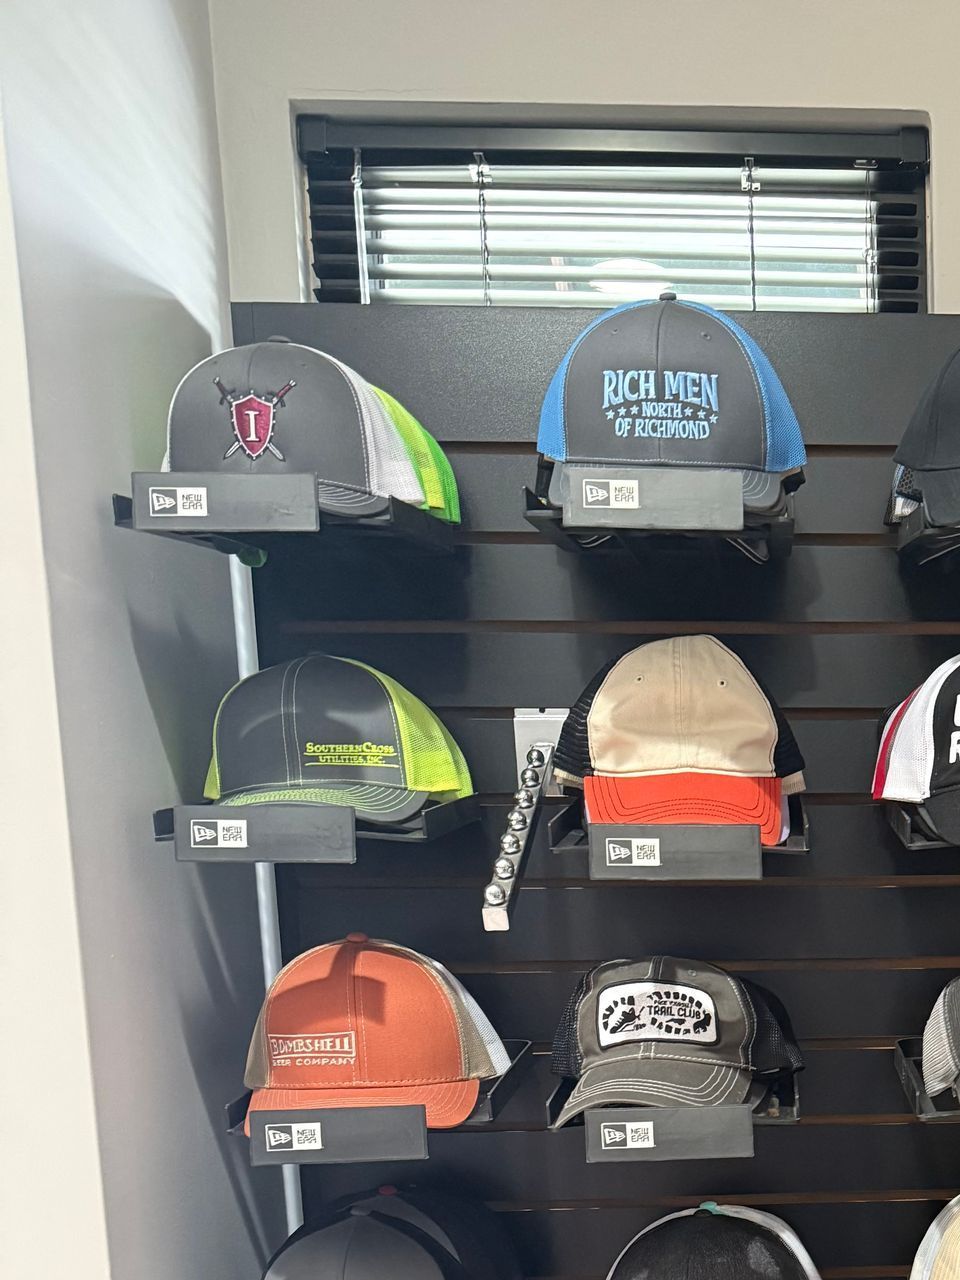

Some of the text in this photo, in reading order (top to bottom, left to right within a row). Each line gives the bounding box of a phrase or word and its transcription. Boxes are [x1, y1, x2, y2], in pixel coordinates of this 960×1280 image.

[603, 369, 719, 412] RICH MEN
[641, 401, 683, 418] NORTH
[615, 418, 710, 440] OF RICHMOND
[613, 485, 634, 494] NEW
[181, 492, 203, 502] NEW
[613, 494, 634, 502] ERA
[181, 502, 203, 510] ERA
[221, 825, 242, 833] NEW
[221, 833, 242, 842] ERA
[635, 843, 656, 852] NEW
[635, 852, 656, 860] ERA
[647, 1005, 702, 1020] TRAIL CLUB
[271, 1036, 351, 1055] BOMBSHELL
[295, 1128, 317, 1136] NEW
[629, 1126, 650, 1134] NEW
[295, 1136, 317, 1144] ERA
[629, 1134, 650, 1142] ERA
